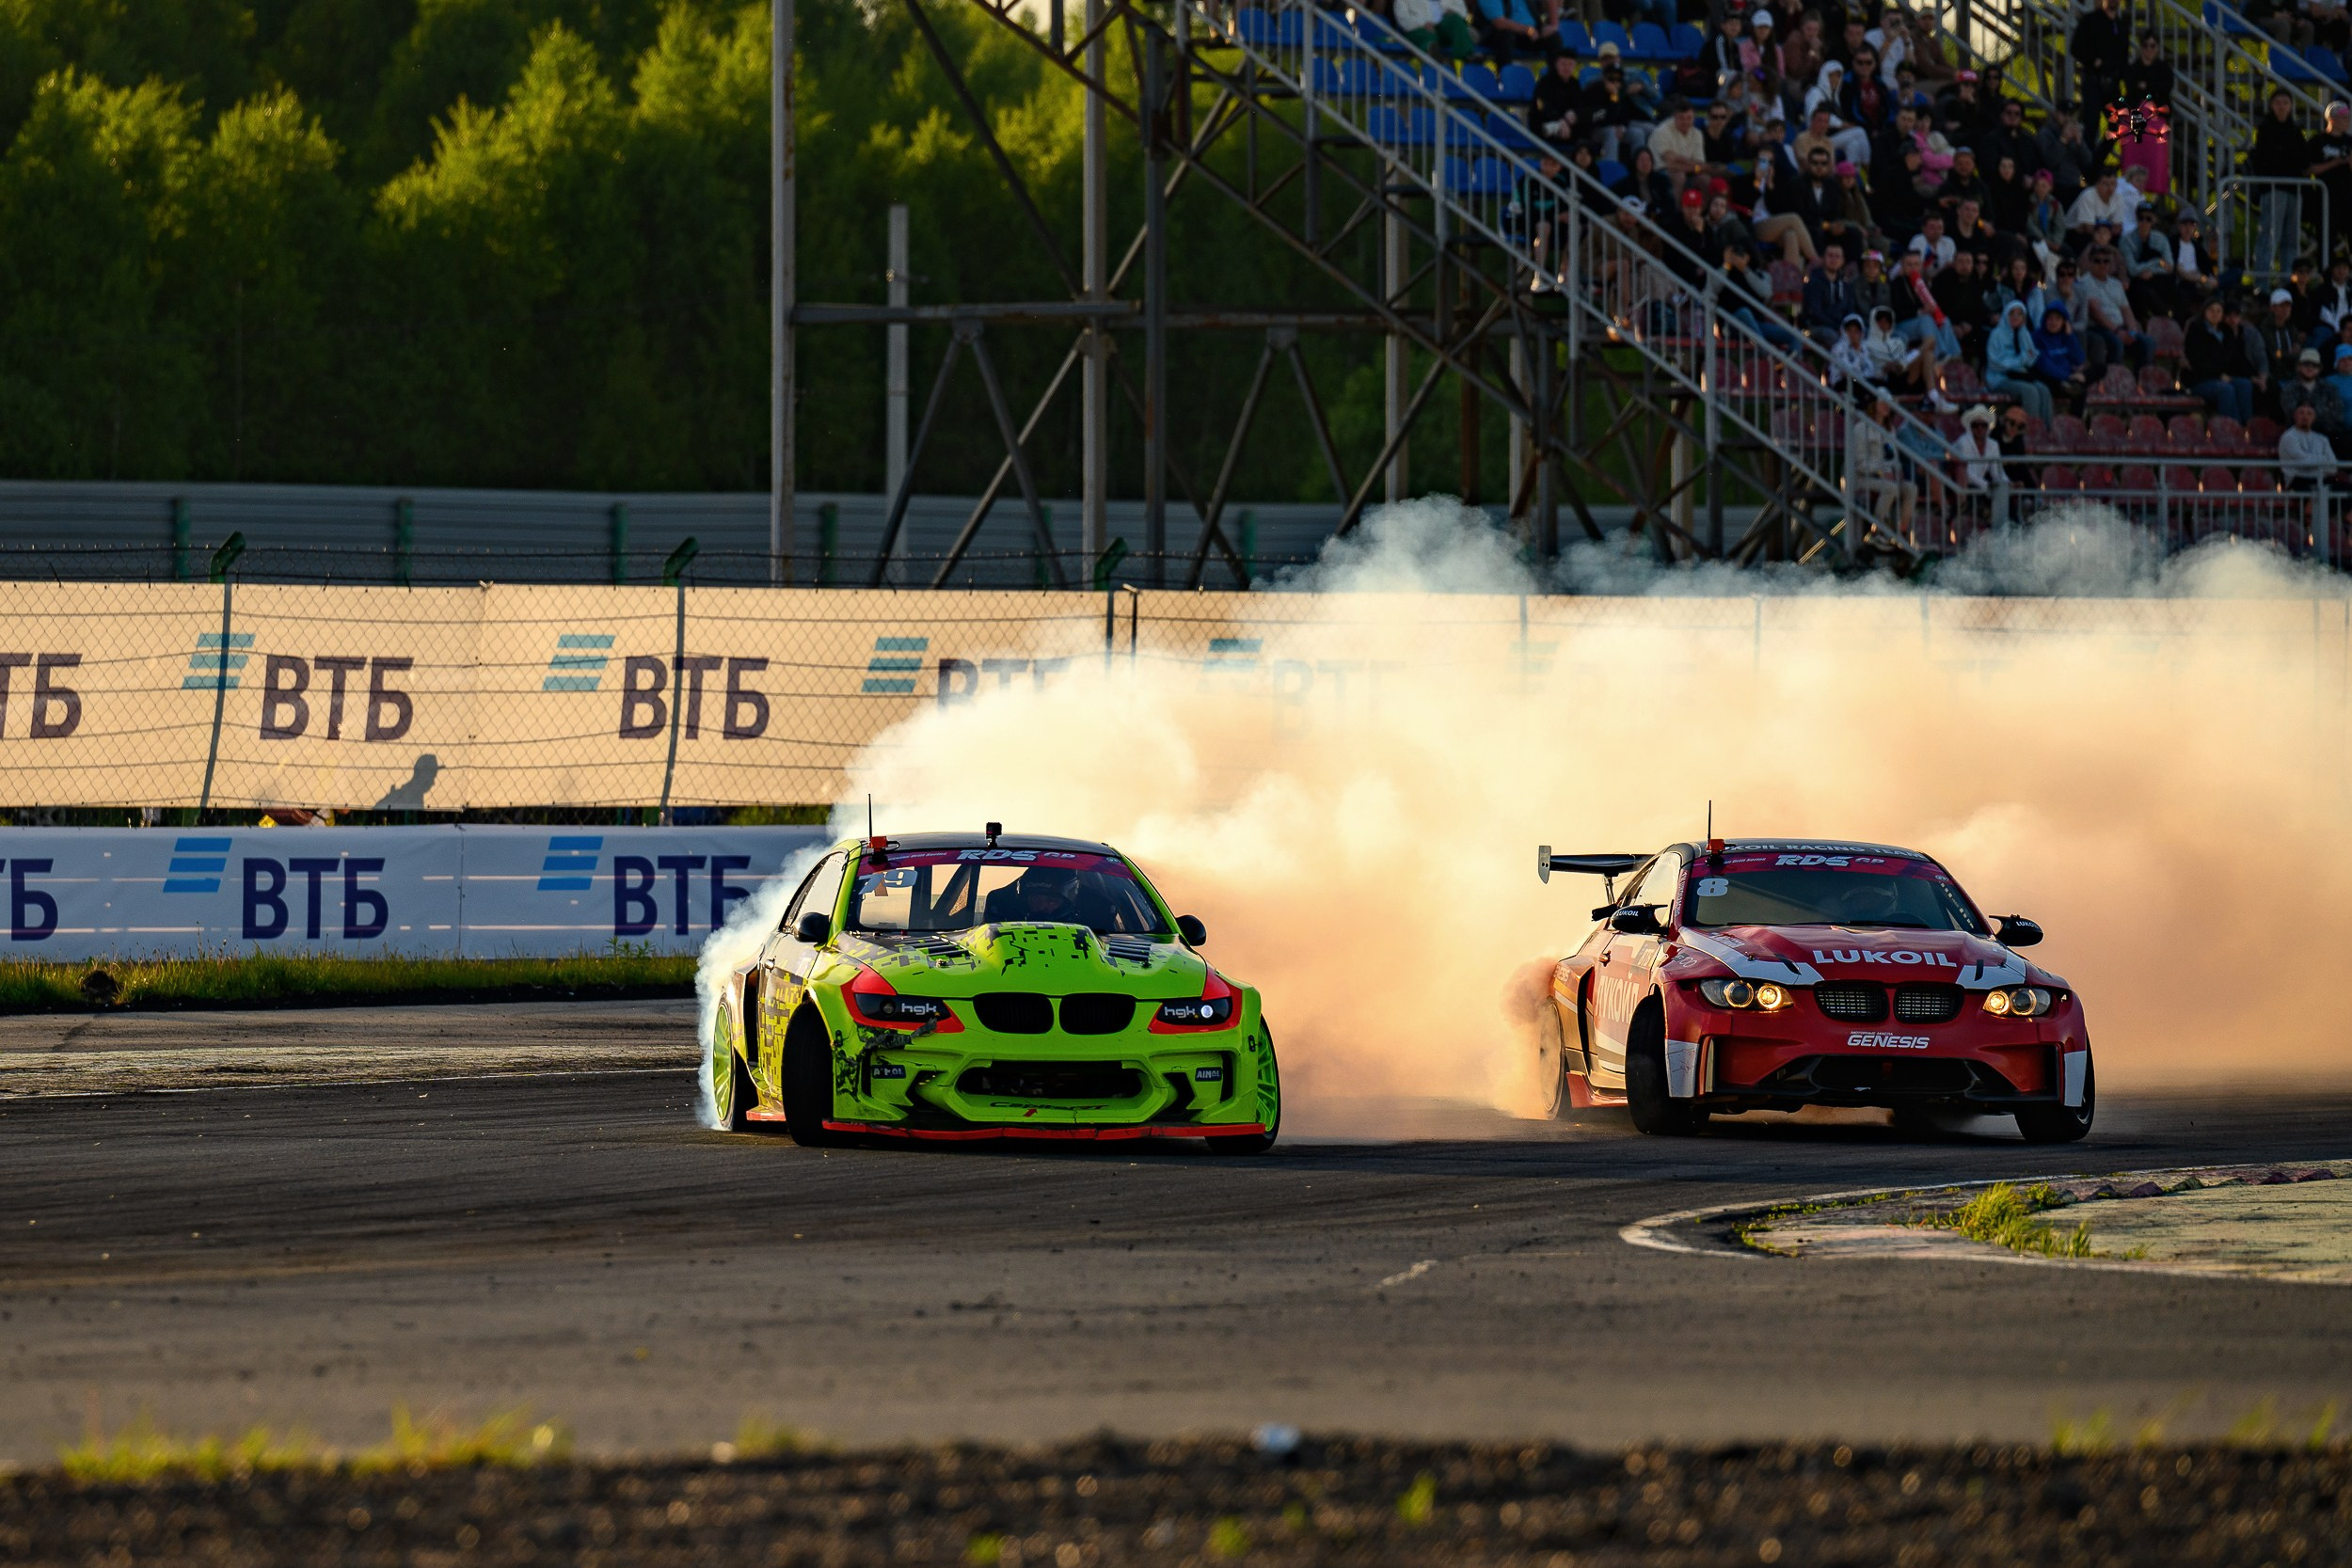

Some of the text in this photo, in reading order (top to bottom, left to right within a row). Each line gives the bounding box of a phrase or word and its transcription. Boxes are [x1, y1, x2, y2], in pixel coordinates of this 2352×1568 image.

[260, 654, 414, 741] ВТБ
[618, 656, 771, 741] ВТБ
[957, 848, 1041, 862] RDS
[1774, 854, 1853, 866] RDS
[1786, 844, 1866, 852] RACING
[1868, 847, 1928, 859] TEAM
[858, 869, 918, 895] 79
[1696, 878, 1729, 897] 8
[242, 857, 389, 941] ВТБ
[1812, 949, 1958, 968] LUKOIL
[1596, 970, 1640, 1024] ЛУКОЙЛ
[901, 1003, 937, 1016] hgk
[1164, 1006, 1195, 1018] hgk
[1848, 1035, 1930, 1050] GENESIS
